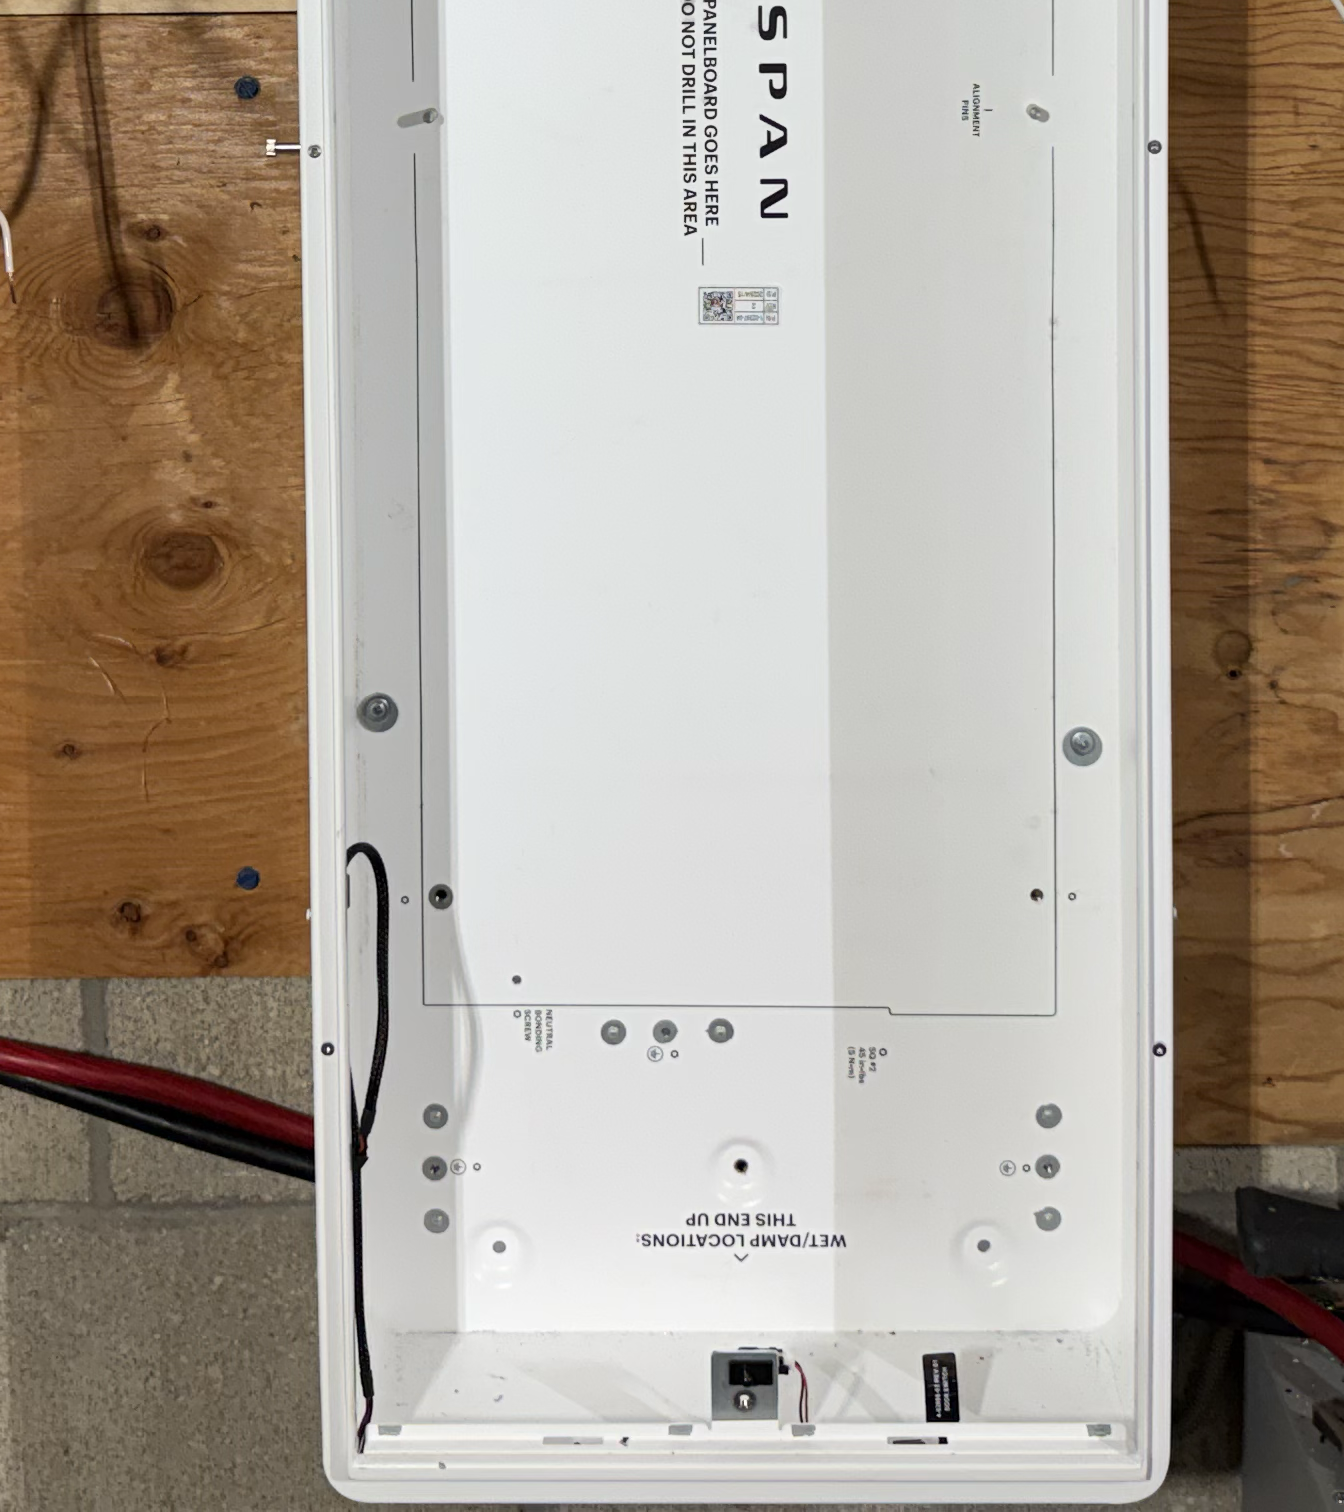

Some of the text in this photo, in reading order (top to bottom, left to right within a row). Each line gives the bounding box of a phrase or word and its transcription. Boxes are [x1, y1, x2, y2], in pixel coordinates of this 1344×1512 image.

[681, 21, 696, 60] NOT
[682, 64, 696, 114] DRILL
[682, 119, 697, 138] IN
[703, 0, 719, 227] PANELBOARD GOES HERE
[758, 5, 789, 219] SPAN
[961, 100, 969, 121] PINS
[972, 83, 980, 137] ALIGNMENT
[683, 142, 697, 184] THIS
[683, 188, 698, 236] AREA
[545, 1009, 553, 1051] NEUTRAL
[859, 1047, 866, 1058] 45
[869, 1047, 876, 1060] SQ
[636, 1232, 846, 1248] WET/DAMP LOCATIONS:
[686, 1213, 796, 1227] THIS END UP
